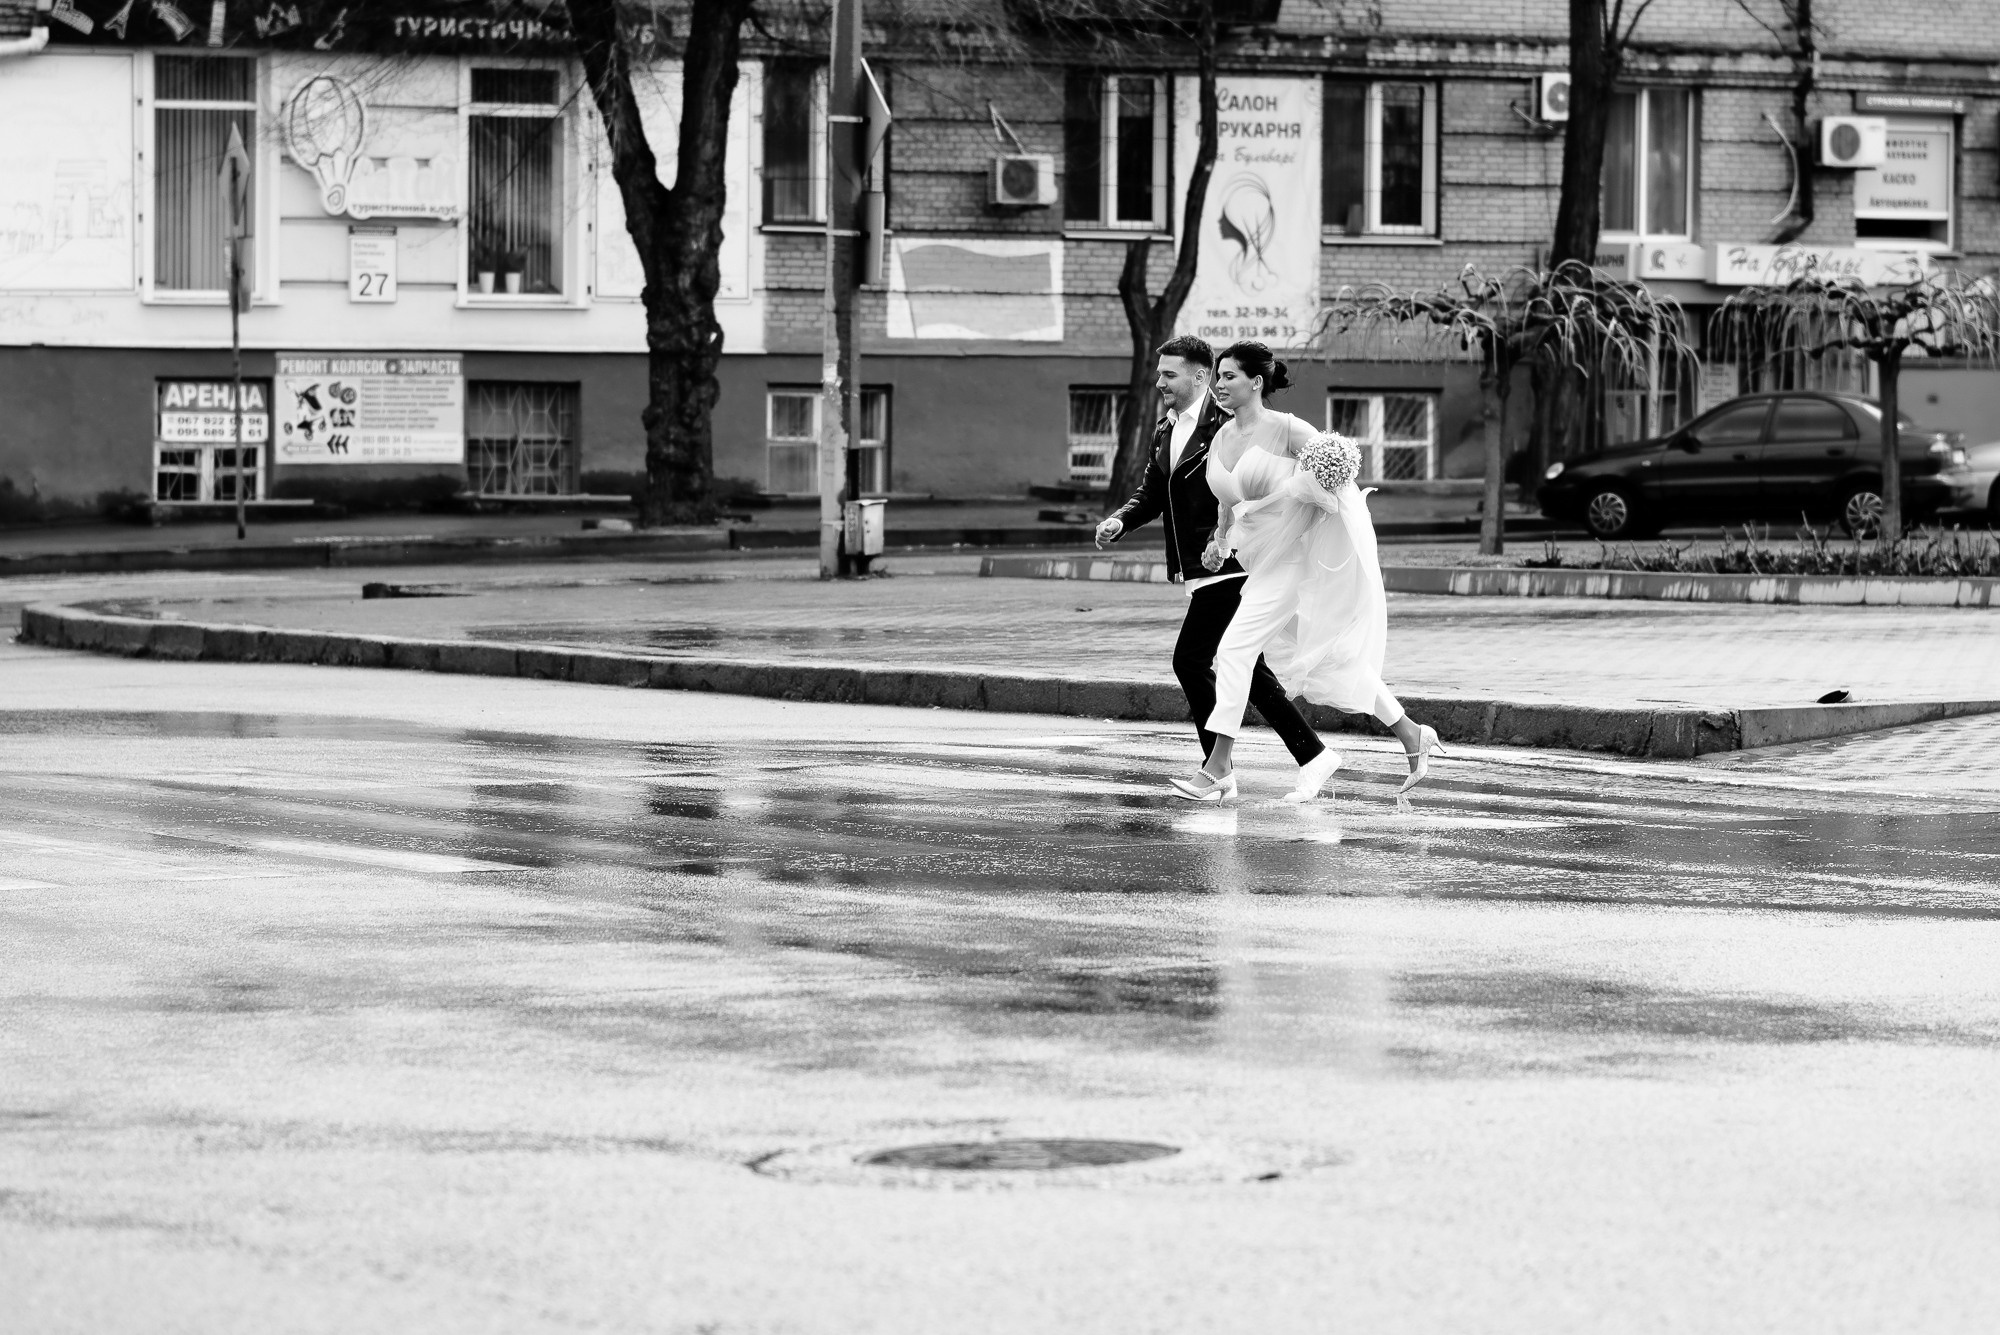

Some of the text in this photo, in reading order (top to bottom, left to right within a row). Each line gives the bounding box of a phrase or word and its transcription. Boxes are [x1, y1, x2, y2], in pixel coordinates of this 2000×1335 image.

[1882, 173, 1917, 186] КАСКО
[429, 204, 458, 218] клуб
[1727, 247, 1760, 272] На
[359, 273, 388, 297] 27
[1206, 306, 1289, 318] тел. 32-19-34
[1198, 325, 1234, 339] (068)
[280, 359, 460, 374] РЕМОНТ КОЛЯСОК ЗАПЧАСТИ
[165, 383, 265, 411] АРЕНДА
